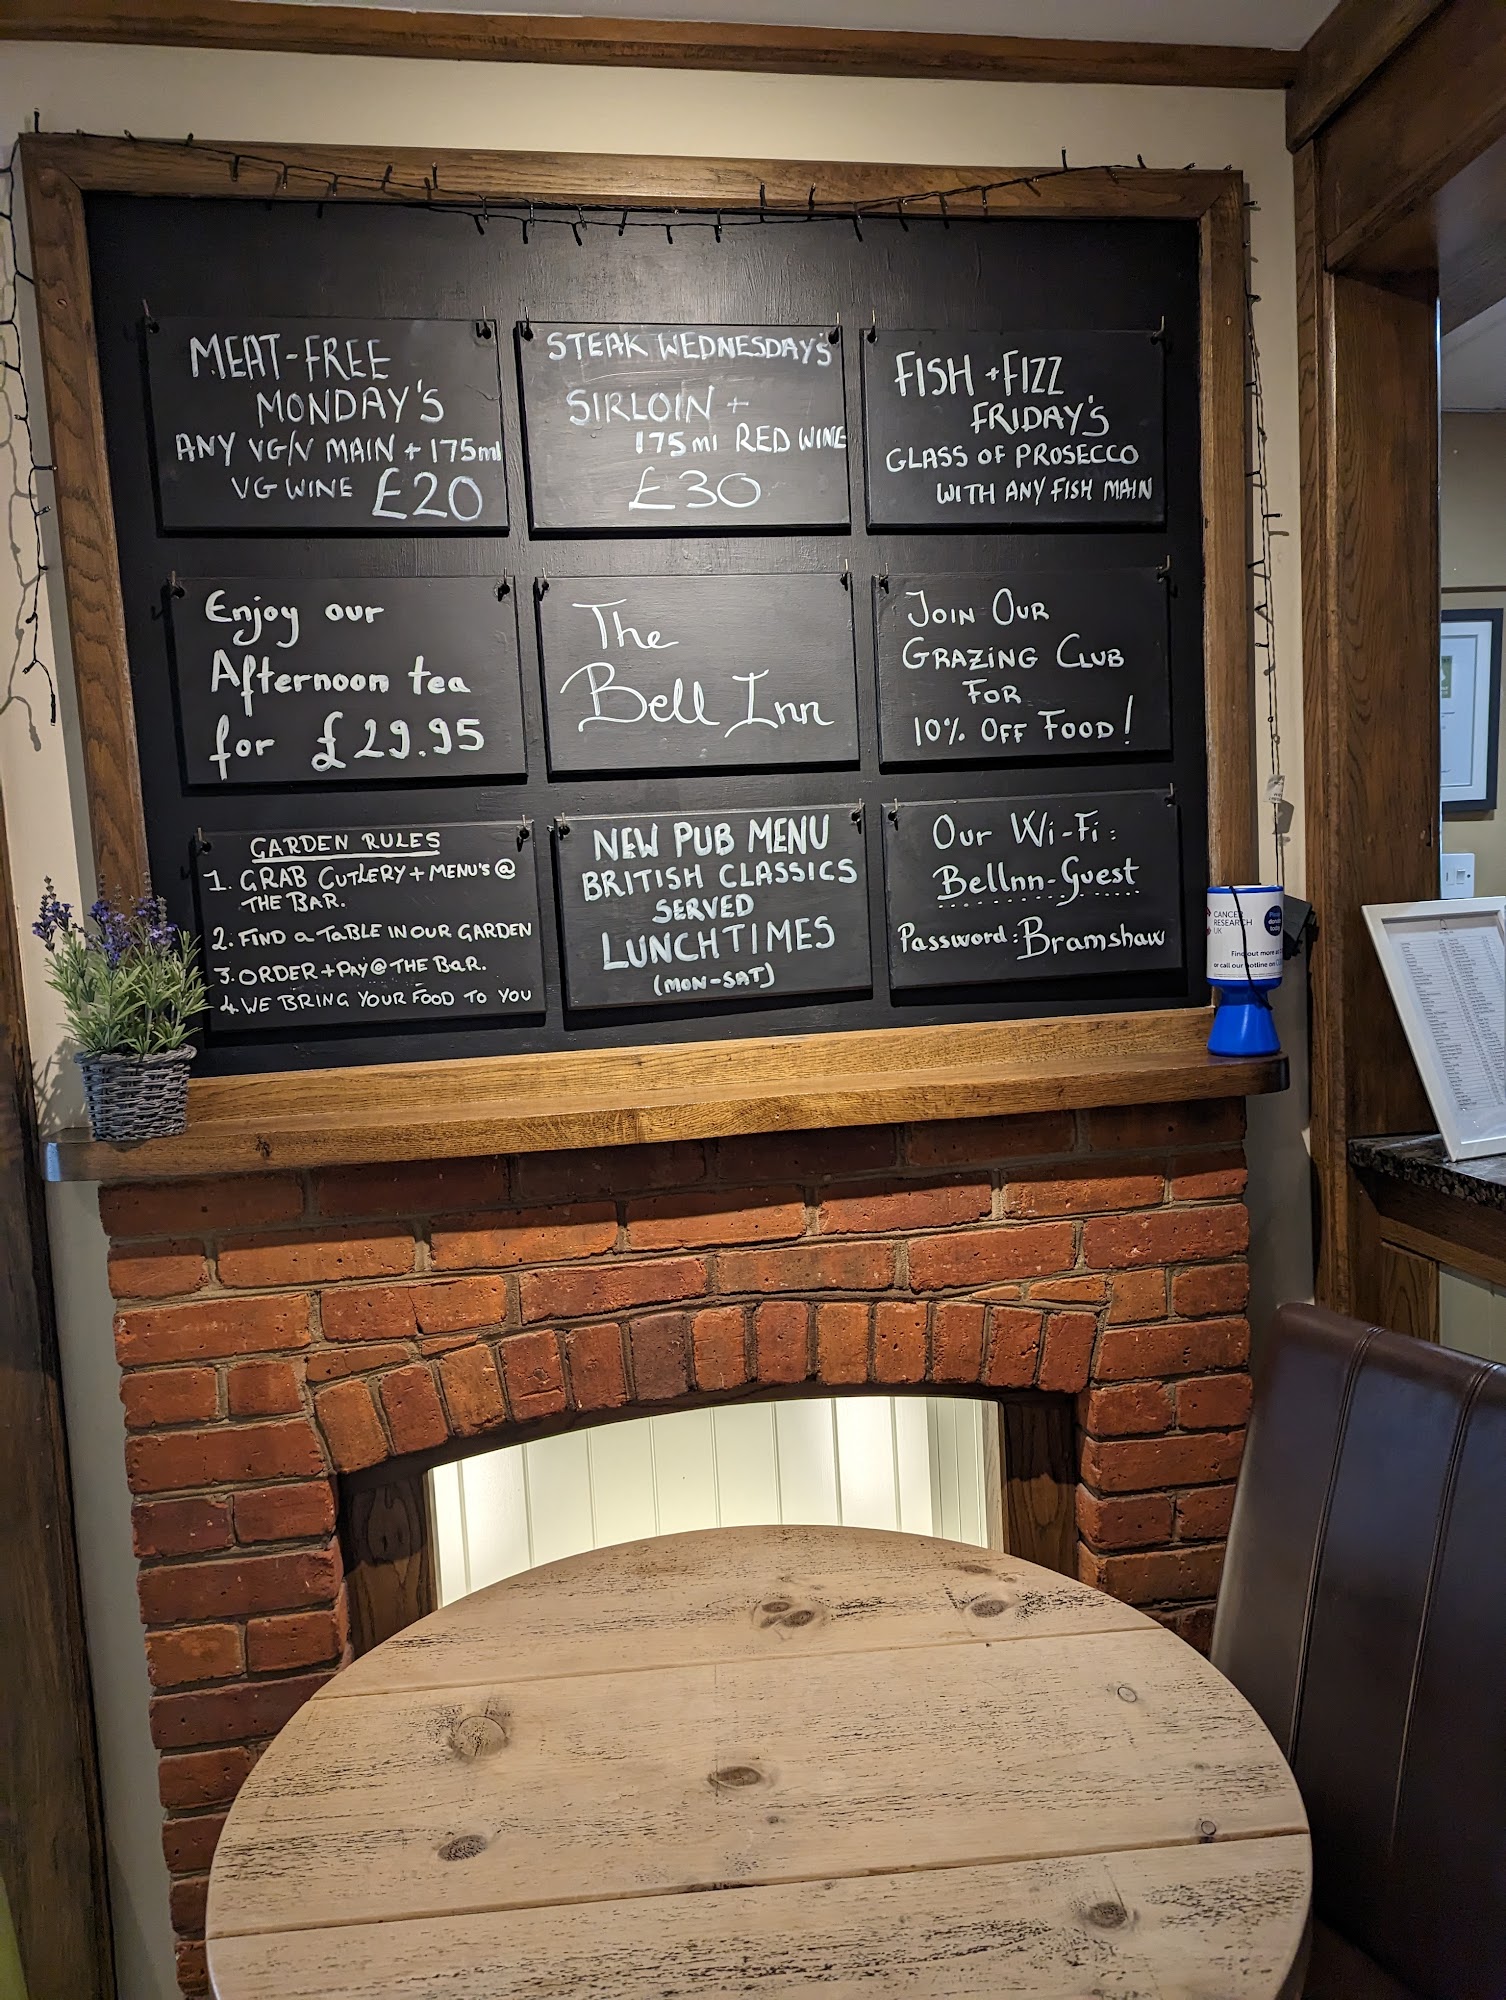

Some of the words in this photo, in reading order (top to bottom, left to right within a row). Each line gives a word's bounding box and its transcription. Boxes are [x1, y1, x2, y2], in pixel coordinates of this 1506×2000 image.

[189, 333, 391, 382] MEAT-FREE
[547, 331, 648, 361] STEAK
[658, 331, 833, 367] WEDNESDAY'S
[894, 350, 974, 397] FISH
[985, 367, 1000, 381] +
[1002, 350, 1064, 396] FIZZ
[256, 379, 445, 429] MONDAY'S
[566, 384, 715, 426] SIRLOIN
[726, 397, 749, 413] +
[970, 394, 1110, 437] FRIDAY'S
[176, 432, 236, 466] ANY
[249, 430, 314, 466] VG/V
[326, 434, 395, 463] MAIN
[404, 443, 421, 462] +
[736, 422, 791, 453] RED
[799, 425, 847, 450] WINE
[886, 445, 968, 472] GLASS
[978, 445, 1006, 464] OF
[1016, 442, 1140, 469] PROSECCO
[231, 476, 278, 500] VG
[285, 477, 354, 500] WINE
[372, 467, 483, 522] £20
[628, 466, 761, 511] £30
[936, 482, 996, 504] WITH
[1005, 476, 1046, 506] ANY
[1050, 477, 1092, 502] FISH
[1103, 476, 1152, 501] MAIN
[205, 589, 299, 648] Enjoy
[325, 603, 385, 623] our
[572, 599, 679, 649] The
[211, 649, 389, 717] Afternoon
[408, 655, 472, 695] tea
[560, 662, 720, 732] Bell
[724, 669, 835, 738] Inn
[209, 714, 276, 781] for
[311, 711, 484, 772] £29.95
[914, 716, 966, 746] 10%
[250, 834, 349, 859] GARDEN
[362, 832, 441, 850] RULES
[593, 823, 659, 862] NEW
[673, 821, 735, 858] PUB
[749, 813, 830, 855] MENU
[932, 814, 992, 850] Our
[239, 865, 308, 892] GRAB
[428, 861, 491, 882] MENU'S
[581, 863, 704, 902] BRITISH
[719, 858, 858, 889] CLASSICS
[241, 893, 282, 913] THE
[286, 891, 346, 912] BAR.
[652, 893, 755, 924] SERVED
[238, 928, 287, 947] FIND
[457, 922, 533, 942] GARDEN
[1016, 916, 1166, 961] Bramshaw
[238, 962, 318, 986] ORDER
[389, 958, 429, 975] THE
[239, 997, 272, 1015] WE
[277, 993, 349, 1012] BRING
[358, 990, 407, 1007] YOUR
[464, 990, 487, 1003] TO
[499, 988, 533, 1003] YOU
